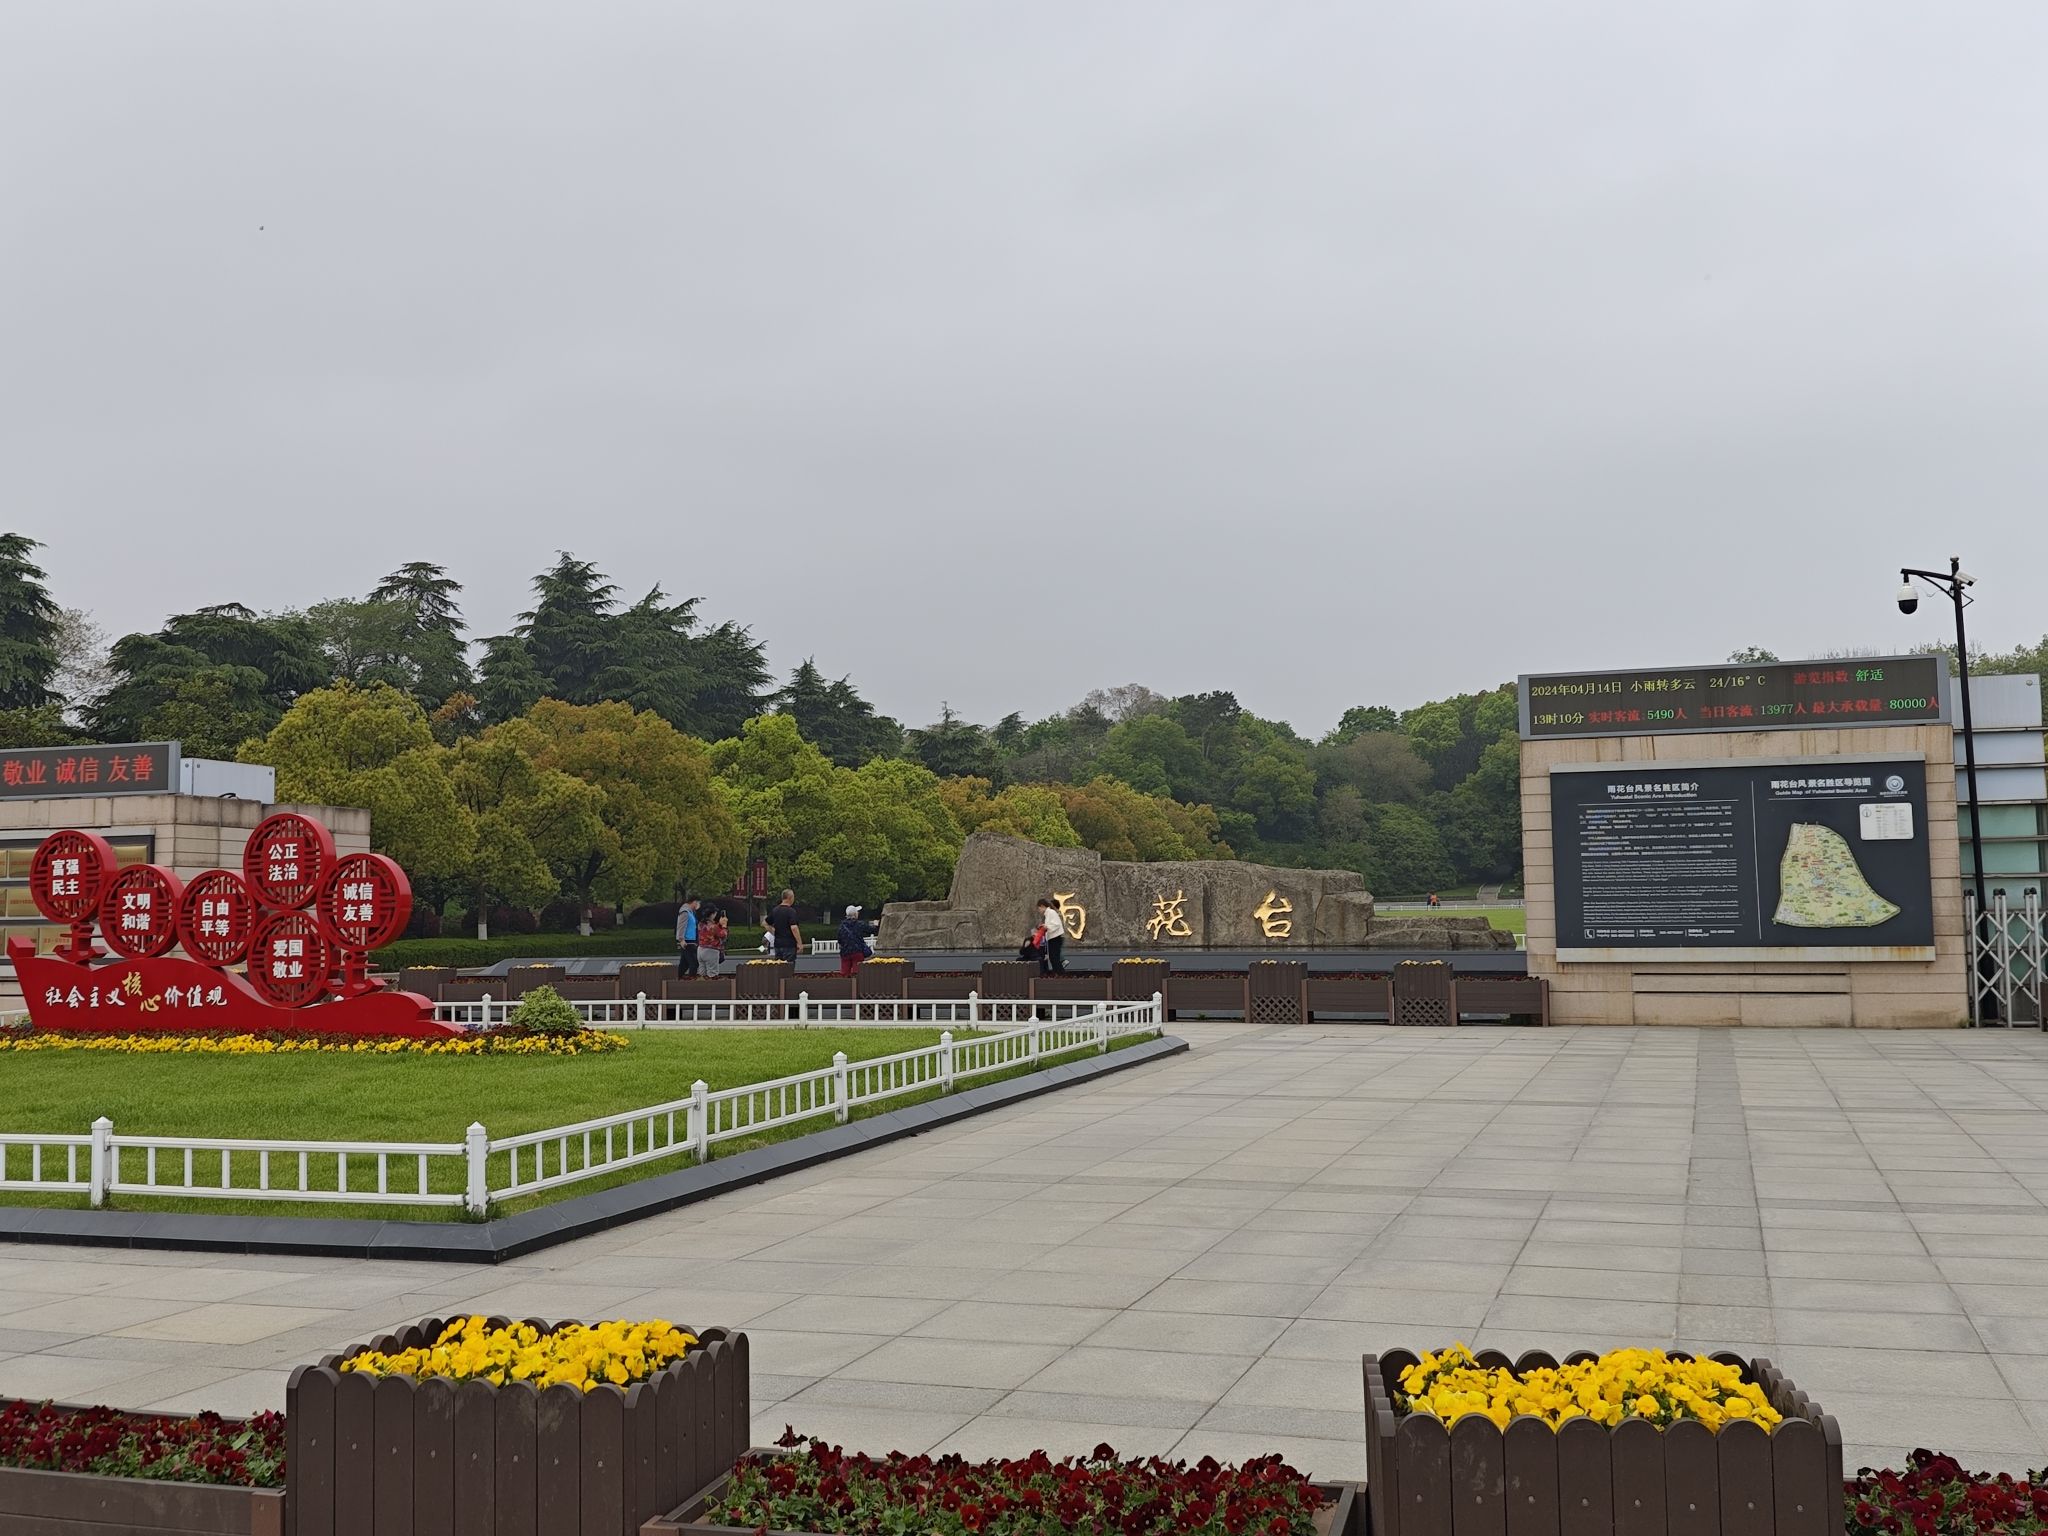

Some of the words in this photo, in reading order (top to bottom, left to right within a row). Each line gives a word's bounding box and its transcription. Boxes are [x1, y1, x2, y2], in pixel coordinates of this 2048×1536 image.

[1531, 681, 1622, 697] 2024年04月14日
[1630, 677, 1696, 692] 小雨转多云
[1532, 711, 1584, 726] 13时10分
[2, 759, 47, 786] 敬业
[56, 757, 99, 783] 诚信
[107, 754, 154, 782] 友善
[1606, 782, 1700, 794] 雨花台风景名胜区简介
[1770, 777, 1872, 790] 雨花台风景名胜区导览图
[268, 843, 299, 861] 公正
[52, 859, 80, 877] 富强
[268, 862, 299, 882] 法治
[52, 879, 80, 896] 民主
[342, 882, 374, 900] 诚信
[122, 893, 151, 910] 文明
[201, 899, 230, 917] 自由
[121, 913, 151, 931] 和谐
[342, 903, 374, 923] 友善
[199, 918, 230, 937] 平等
[272, 938, 304, 958] 爱国
[272, 960, 304, 980] 敬业
[45, 971, 228, 1013] 社会主义核心价值观
